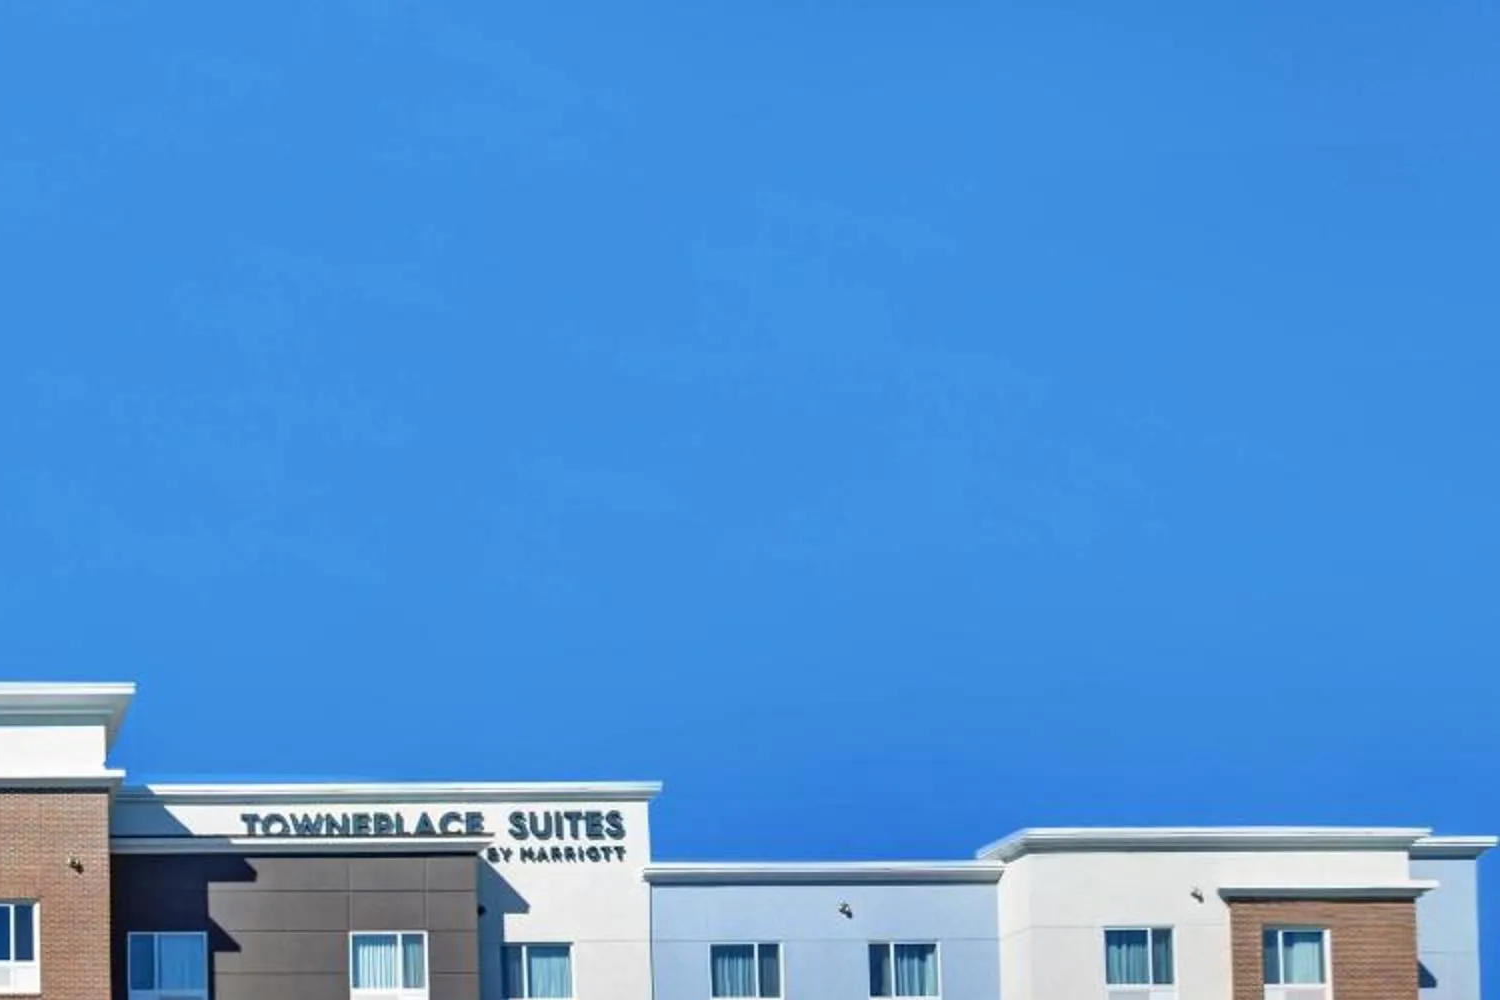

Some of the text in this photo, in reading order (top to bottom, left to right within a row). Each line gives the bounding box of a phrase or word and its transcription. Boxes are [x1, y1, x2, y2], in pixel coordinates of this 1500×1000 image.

[241, 810, 626, 840] TOWNEPLACE SUITES
[487, 846, 627, 863] BY MARRIOTT
